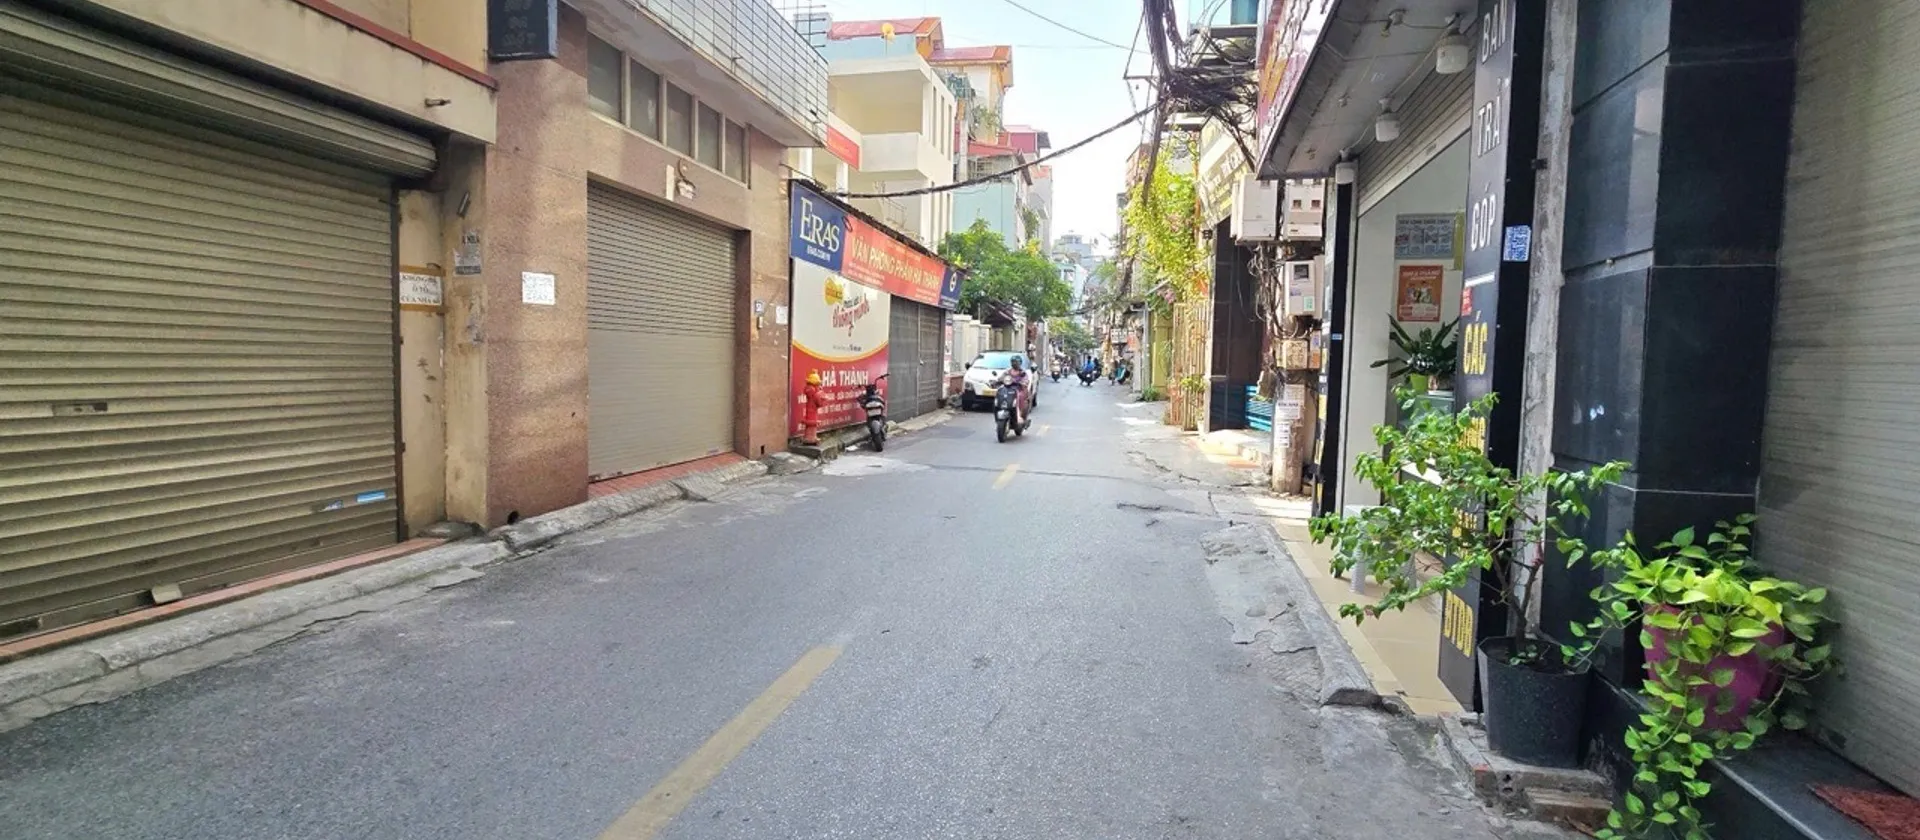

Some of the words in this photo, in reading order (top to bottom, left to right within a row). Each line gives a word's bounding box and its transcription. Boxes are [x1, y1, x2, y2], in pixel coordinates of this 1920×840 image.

[800, 196, 840, 253] ERAS
[1470, 180, 1497, 252] GÓP
[1463, 310, 1488, 375] CÁC
[822, 365, 837, 387] HÀ
[839, 365, 870, 386] THÀNH
